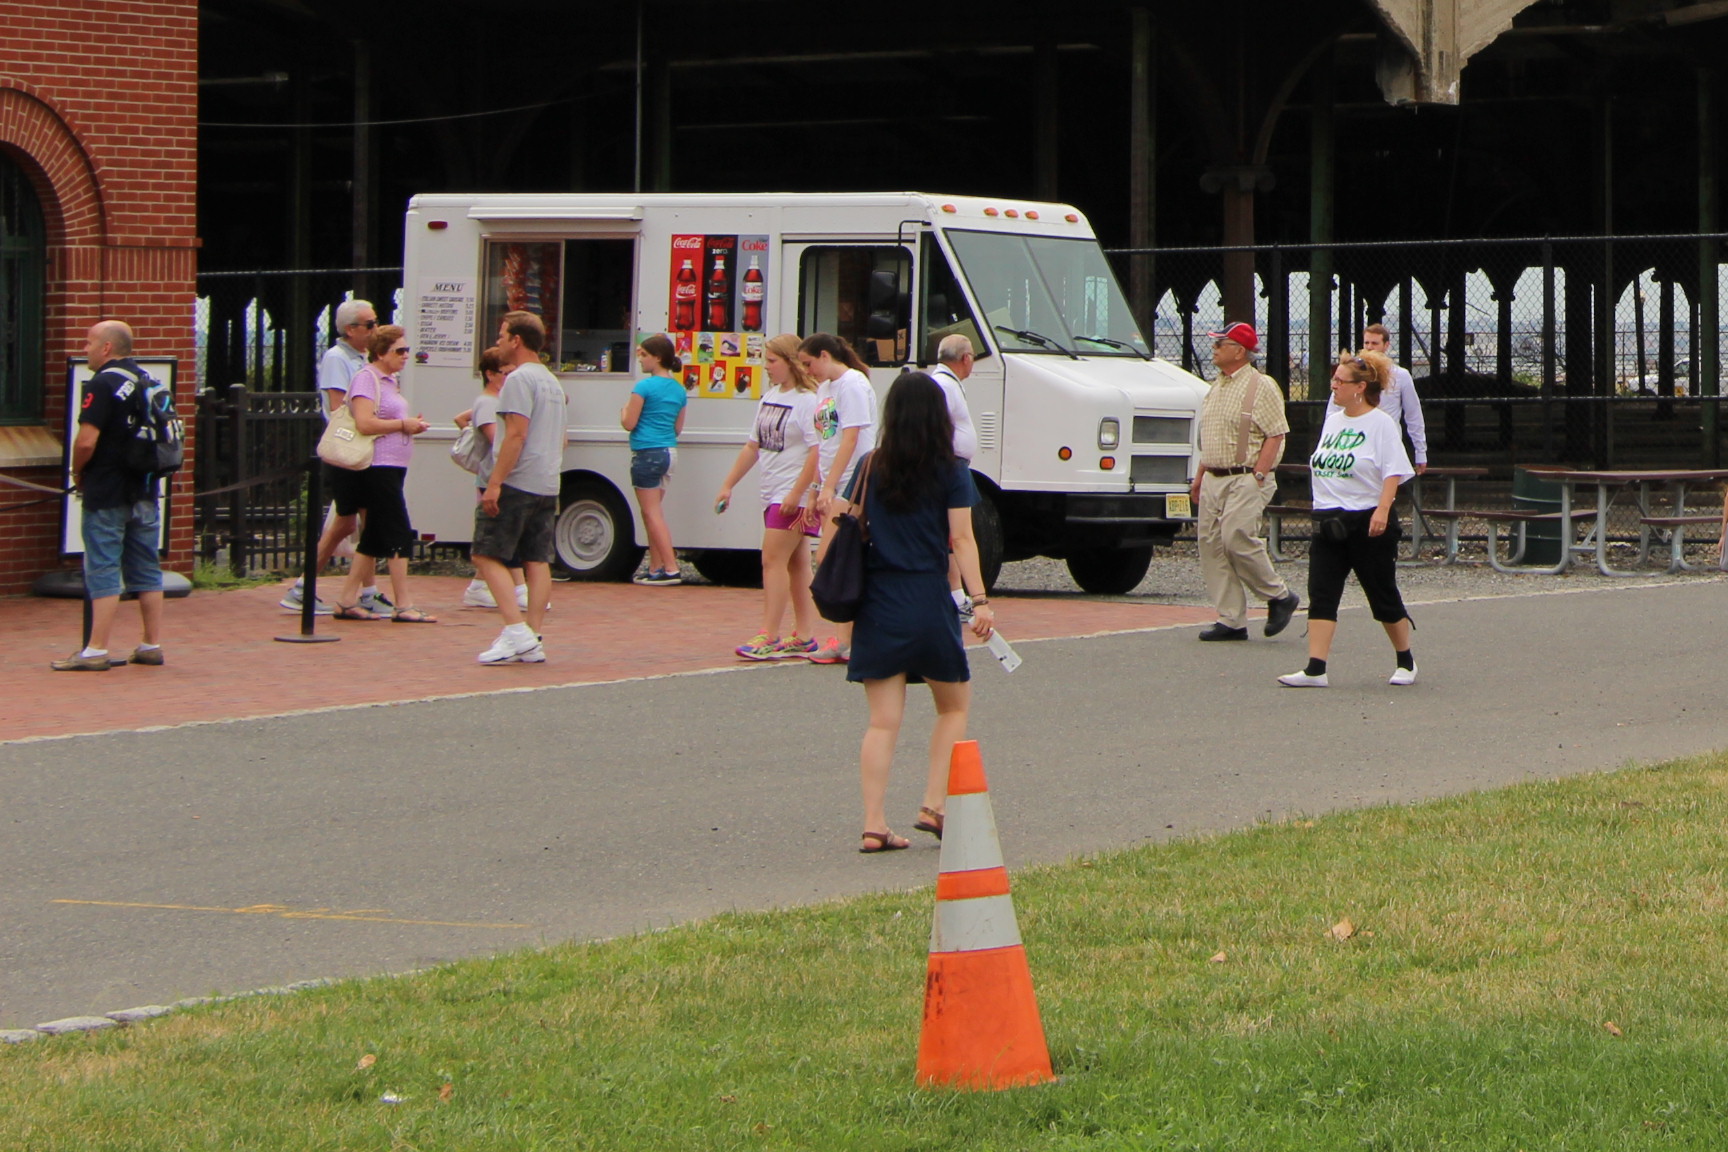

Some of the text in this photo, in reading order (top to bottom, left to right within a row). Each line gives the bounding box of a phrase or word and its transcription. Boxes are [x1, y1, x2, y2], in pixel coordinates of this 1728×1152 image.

[741, 239, 768, 252] Coke
[432, 282, 466, 292] MENU
[1311, 452, 1355, 472] WOOD
